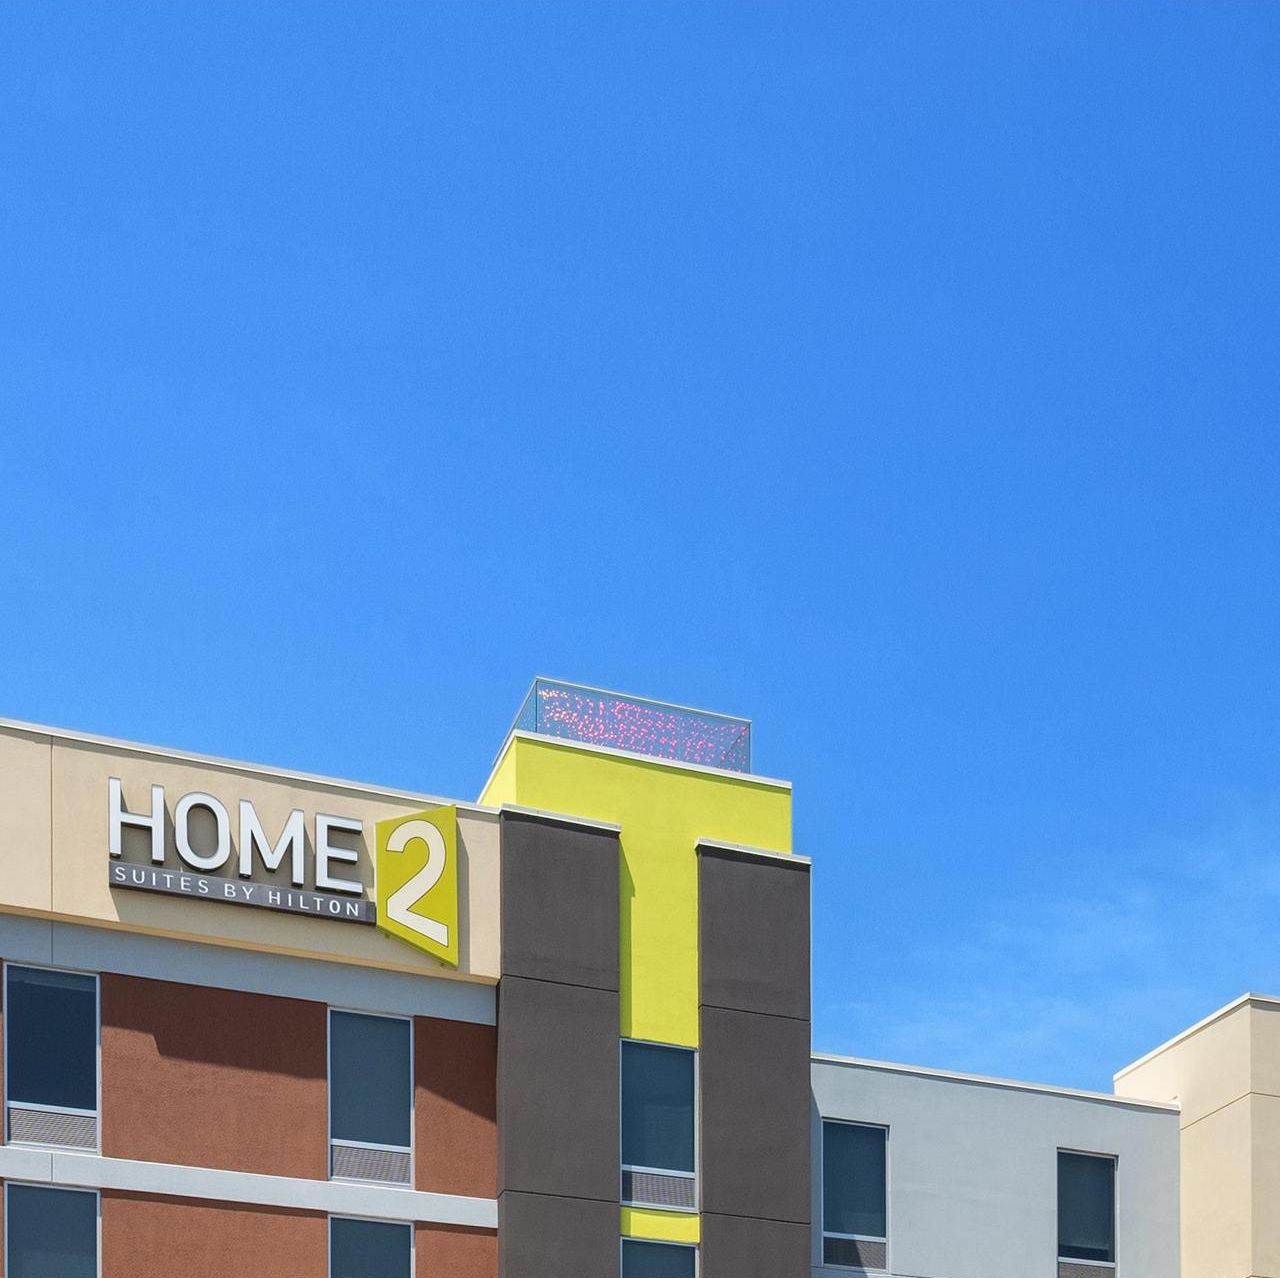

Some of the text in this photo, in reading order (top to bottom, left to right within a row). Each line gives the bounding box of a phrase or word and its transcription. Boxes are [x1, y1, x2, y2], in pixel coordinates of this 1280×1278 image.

[114, 866, 360, 918] SUITES BY HILTON
